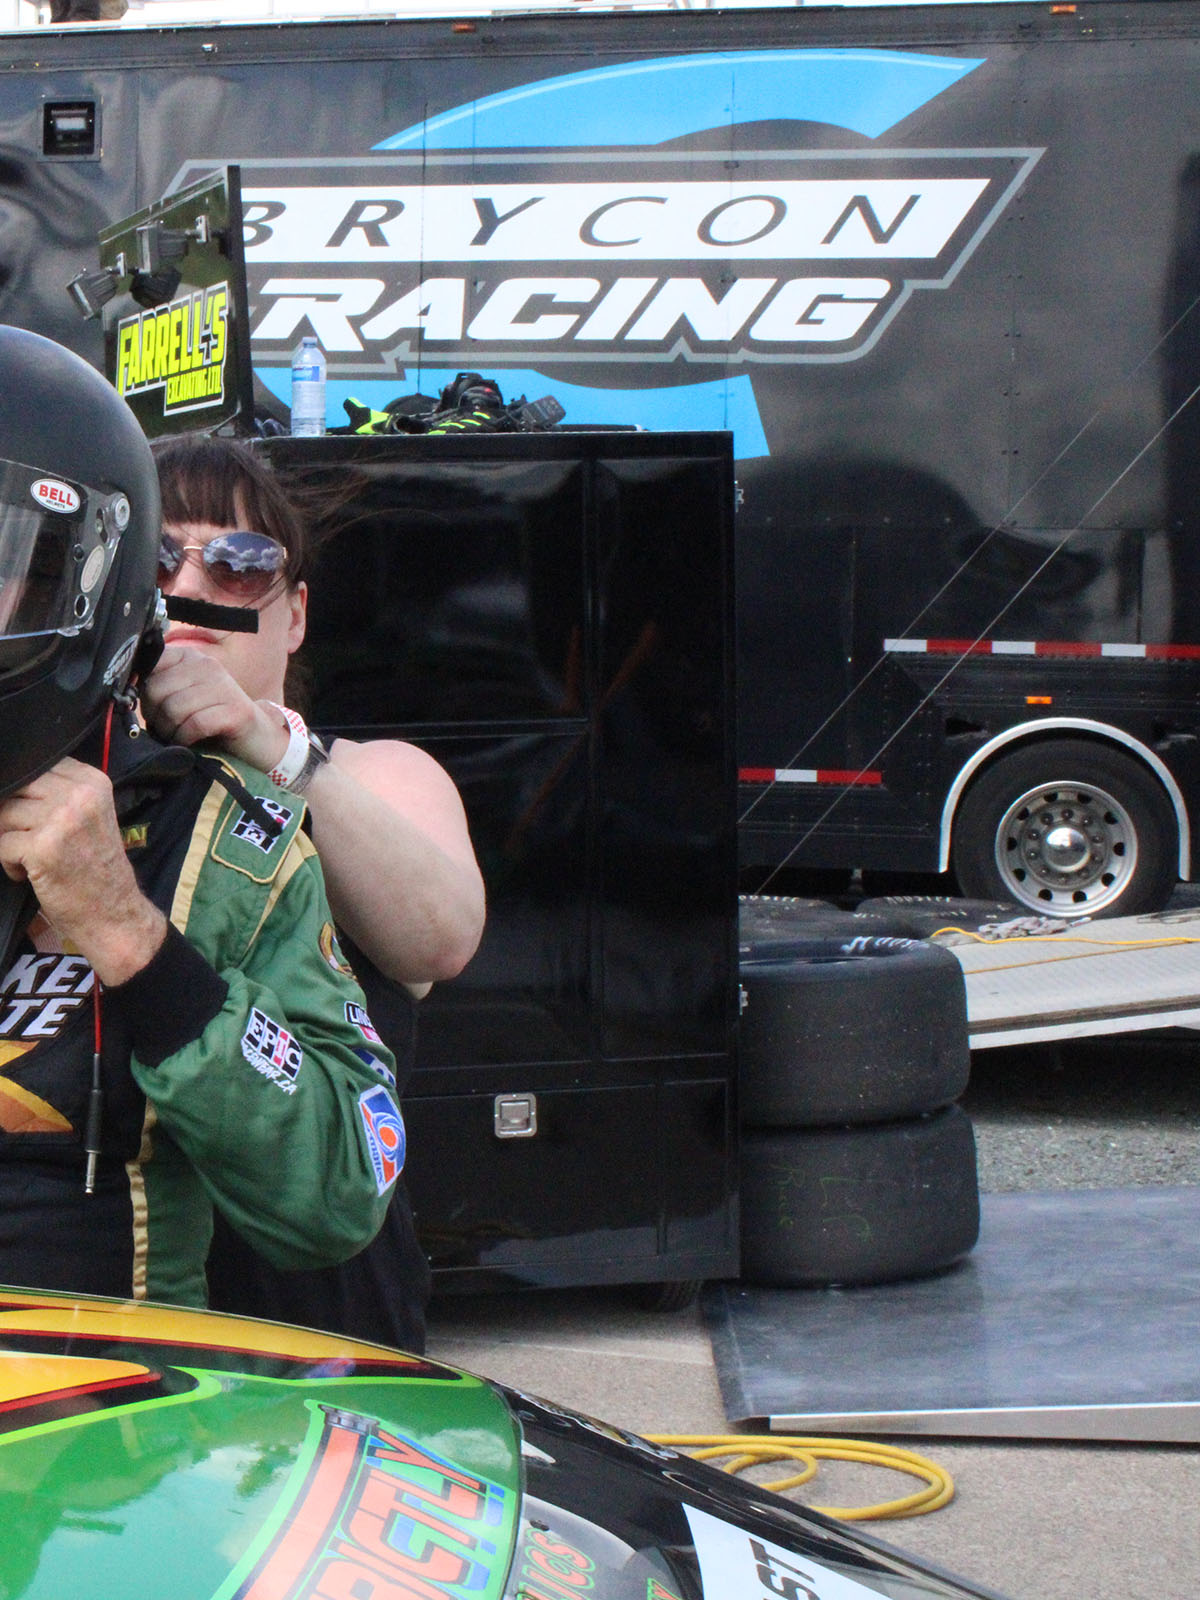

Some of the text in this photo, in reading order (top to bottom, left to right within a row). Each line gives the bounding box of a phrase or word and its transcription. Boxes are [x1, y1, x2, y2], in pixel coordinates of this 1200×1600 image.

[241, 194, 923, 249] BRYCON
[249, 276, 890, 352] RACING
[117, 291, 227, 397] FARRELL'S
[38, 484, 75, 508] BELL
[247, 1016, 302, 1073] EPIC
